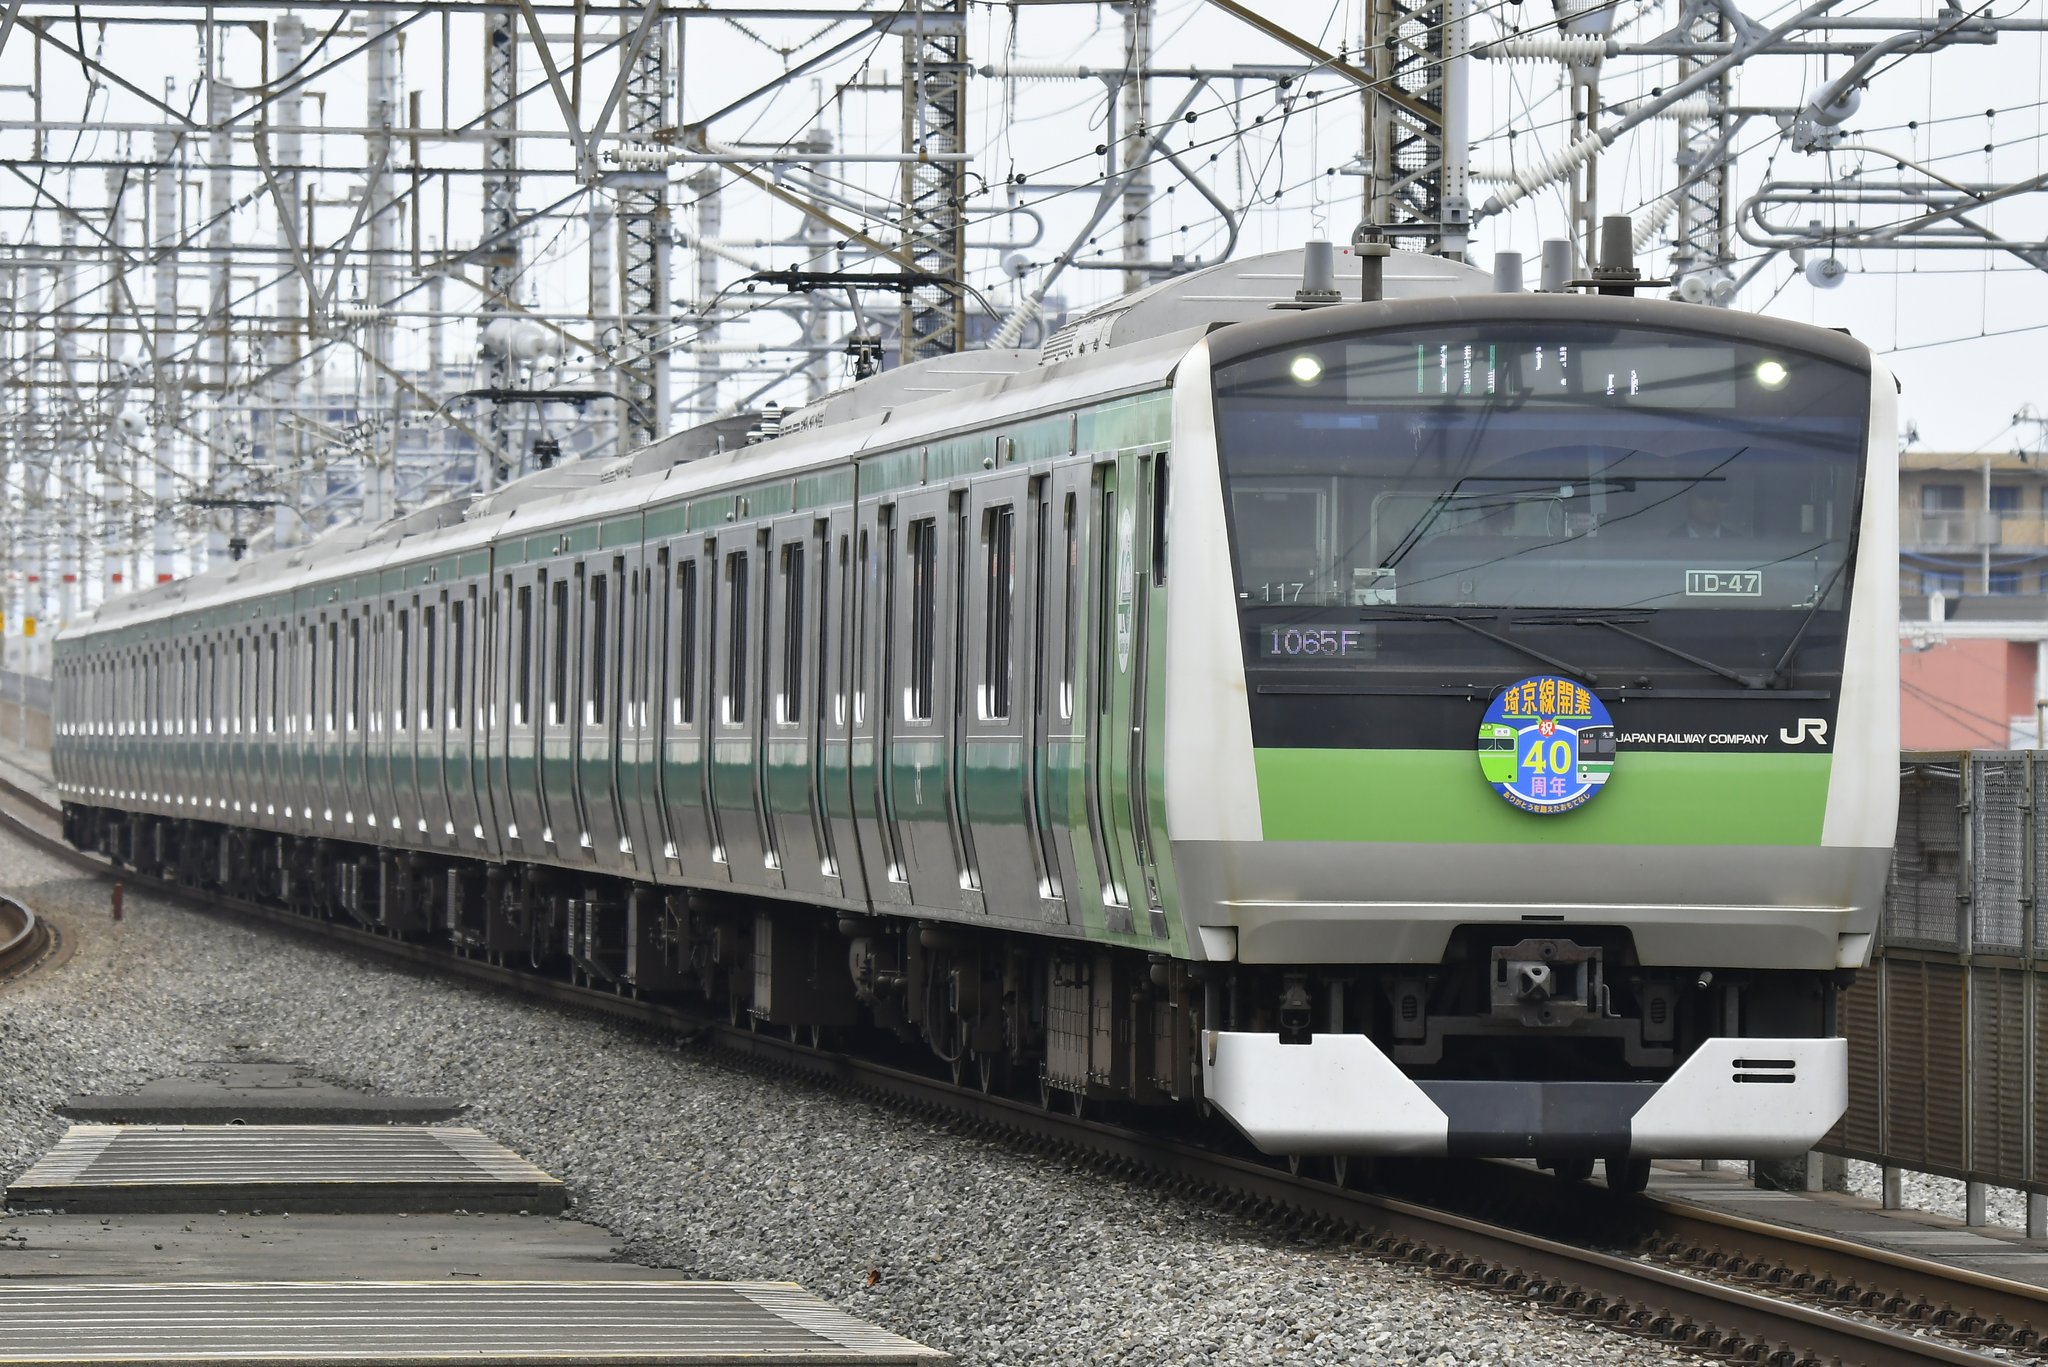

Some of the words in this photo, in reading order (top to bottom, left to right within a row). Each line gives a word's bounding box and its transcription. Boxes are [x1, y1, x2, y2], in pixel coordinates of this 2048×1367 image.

[1261, 582, 1304, 602] 117
[1694, 574, 1758, 592] ID-47
[1271, 629, 1361, 656] 1065F
[1504, 678, 1591, 715] 埼京線開業
[1540, 721, 1554, 737] 祝
[1616, 732, 1656, 743] JAPAN
[1657, 733, 1707, 744] RAILWAY
[1709, 734, 1769, 744] COMPANY
[1779, 718, 1828, 745] JR
[1521, 740, 1572, 775] 40
[1531, 777, 1567, 798] 周年
